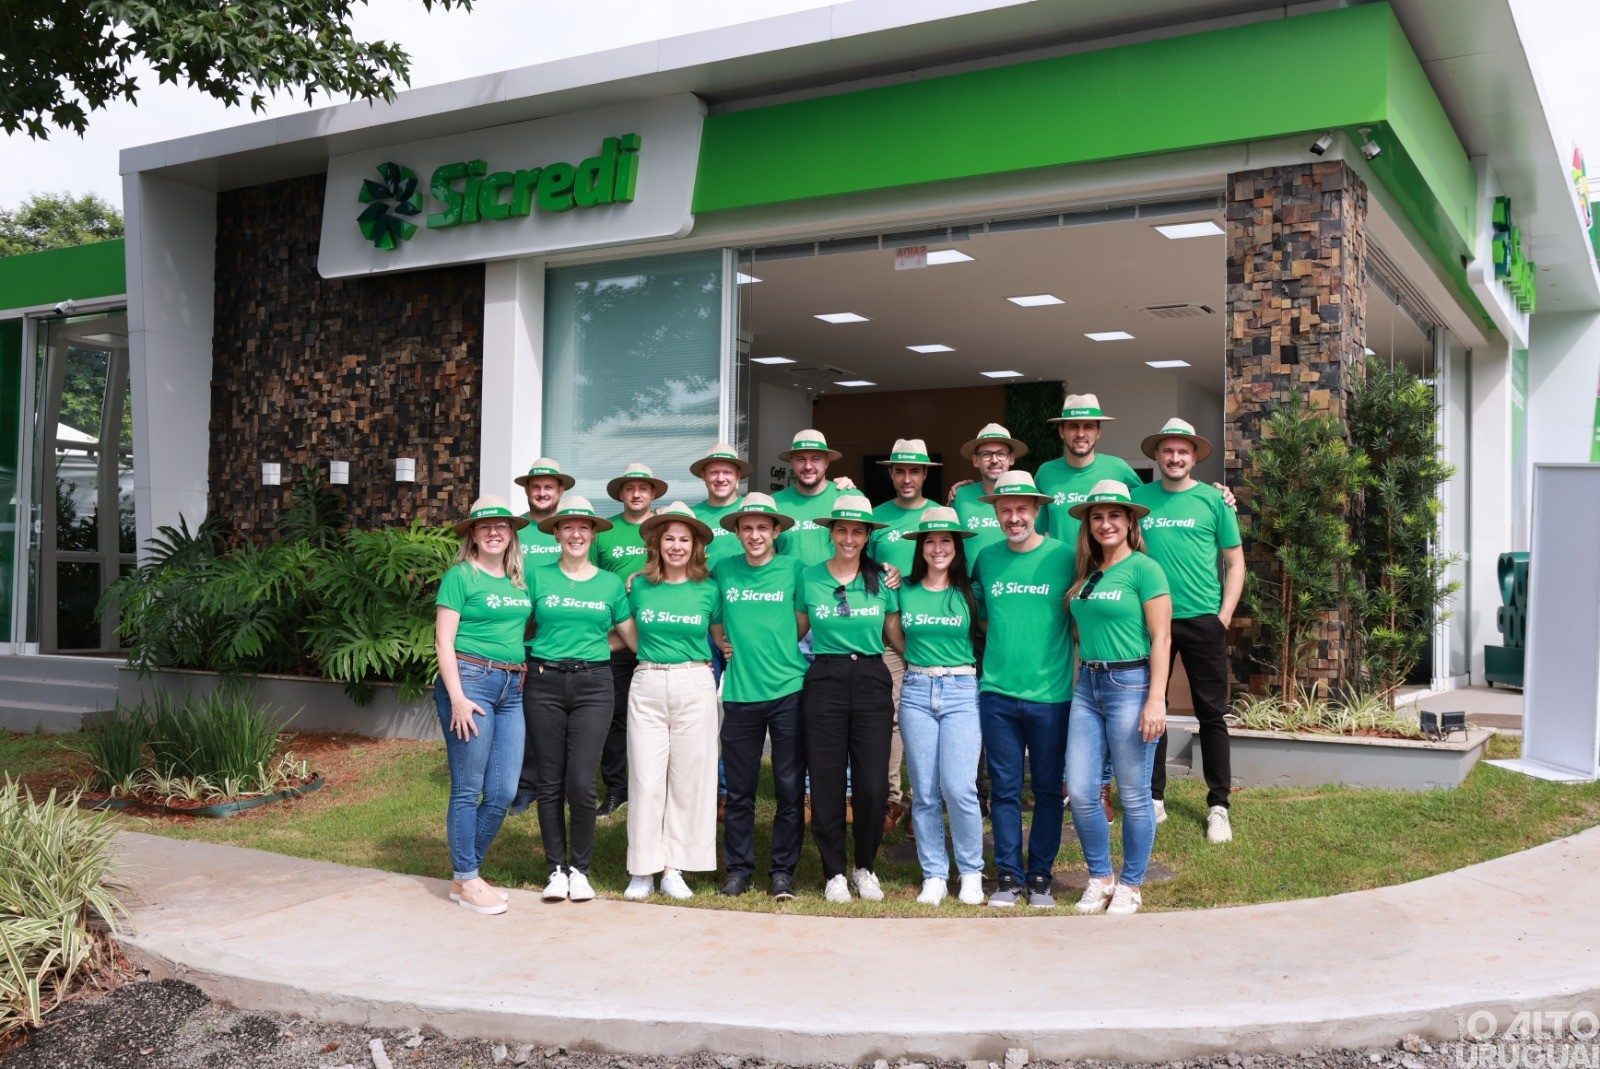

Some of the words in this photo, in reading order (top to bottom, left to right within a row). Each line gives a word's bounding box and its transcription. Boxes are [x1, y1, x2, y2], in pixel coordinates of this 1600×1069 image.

[427, 133, 641, 229] Sicredi
[771, 466, 786, 480] Café
[1155, 518, 1195, 528] Sicredi
[1006, 582, 1049, 595] Sicredi
[741, 589, 784, 602] Sicredi
[561, 597, 606, 611] Sicredi
[657, 611, 702, 625] Sicredi
[915, 614, 962, 627] Sicredi
